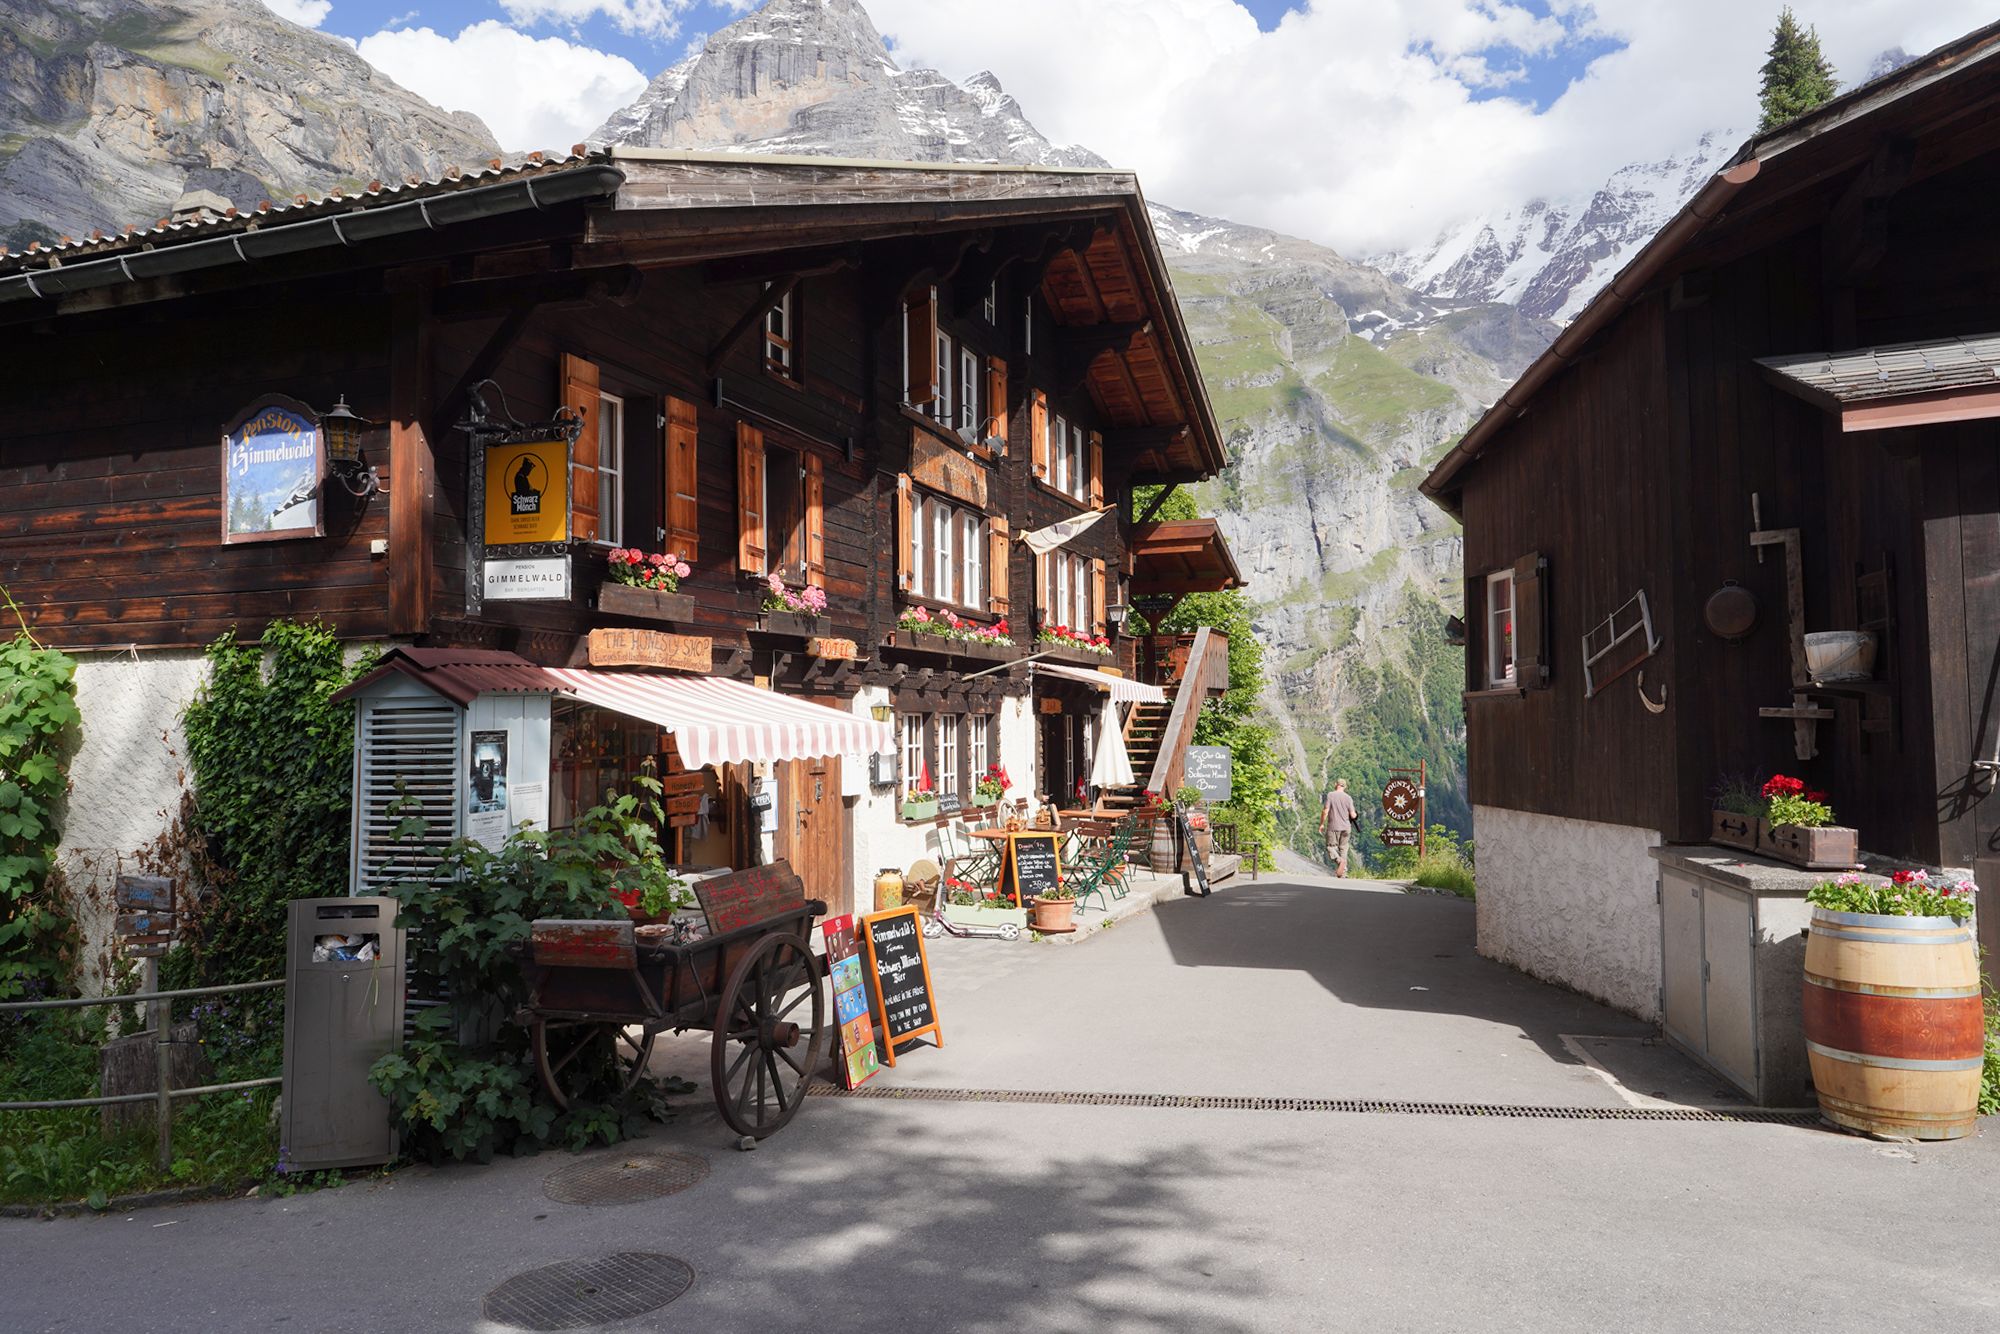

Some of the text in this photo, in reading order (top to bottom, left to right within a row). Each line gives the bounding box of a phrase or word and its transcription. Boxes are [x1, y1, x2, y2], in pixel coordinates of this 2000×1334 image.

[243, 413, 301, 446] Pension
[233, 431, 314, 476] Gimmelwald
[513, 495, 539, 504] Schwarz
[488, 573, 562, 584] GIMMELWALD
[603, 631, 710, 657] THE HONESTY SHOP
[816, 640, 849, 657] HOTEL
[1384, 780, 1417, 800] MOUNTAIN
[1386, 807, 1415, 820] HOSTEL
[872, 920, 916, 943] Gimmelwald's
